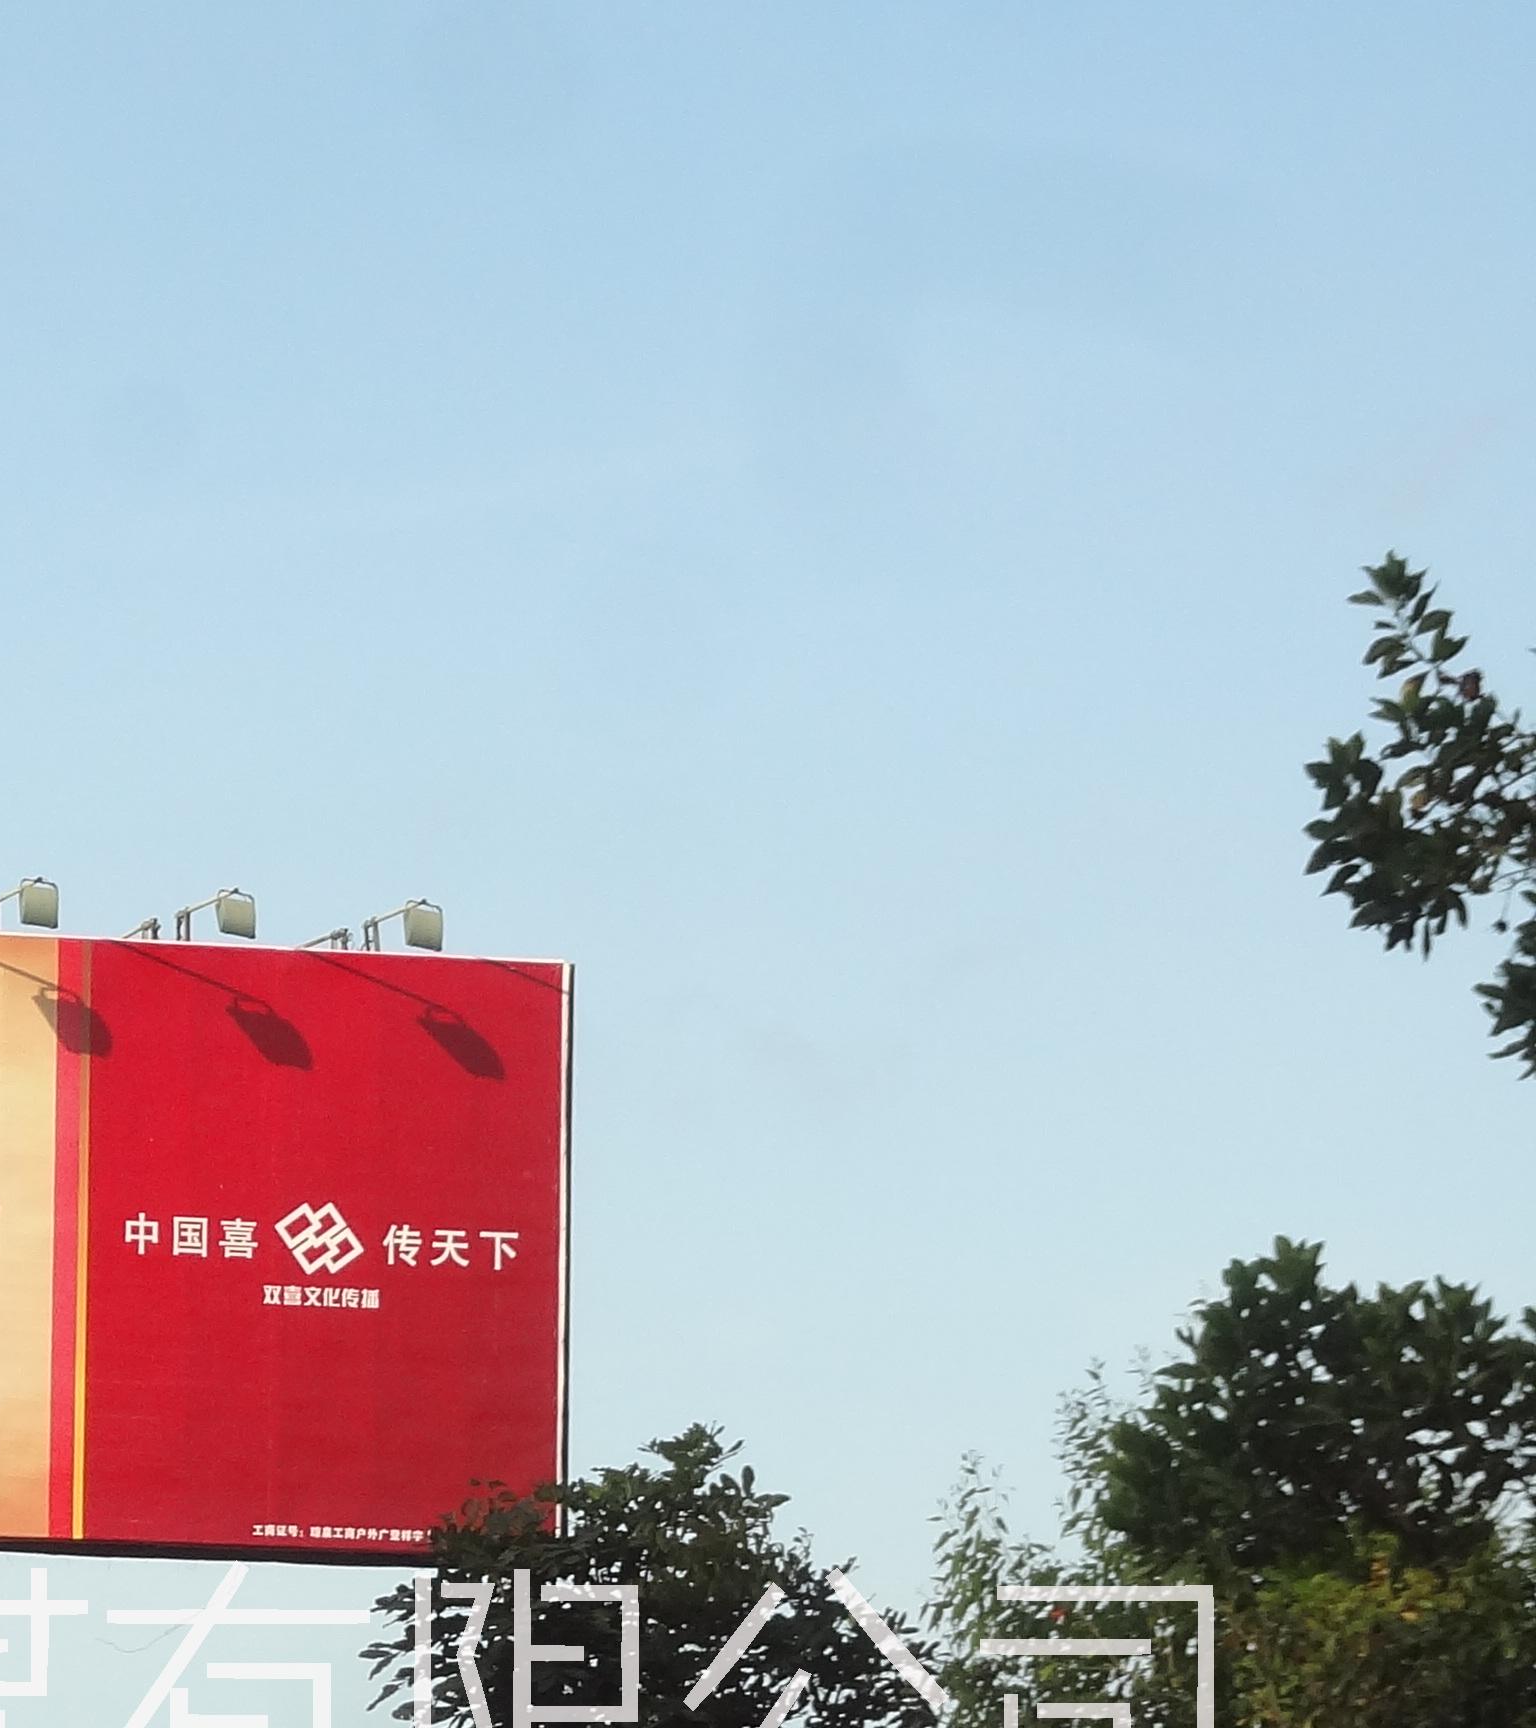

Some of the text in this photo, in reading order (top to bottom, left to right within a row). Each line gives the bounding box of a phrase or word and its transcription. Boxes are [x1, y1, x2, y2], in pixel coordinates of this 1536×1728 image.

[124, 1212, 520, 1271] 中国喜 传天下
[262, 1284, 380, 1309] 双喜文化传播
